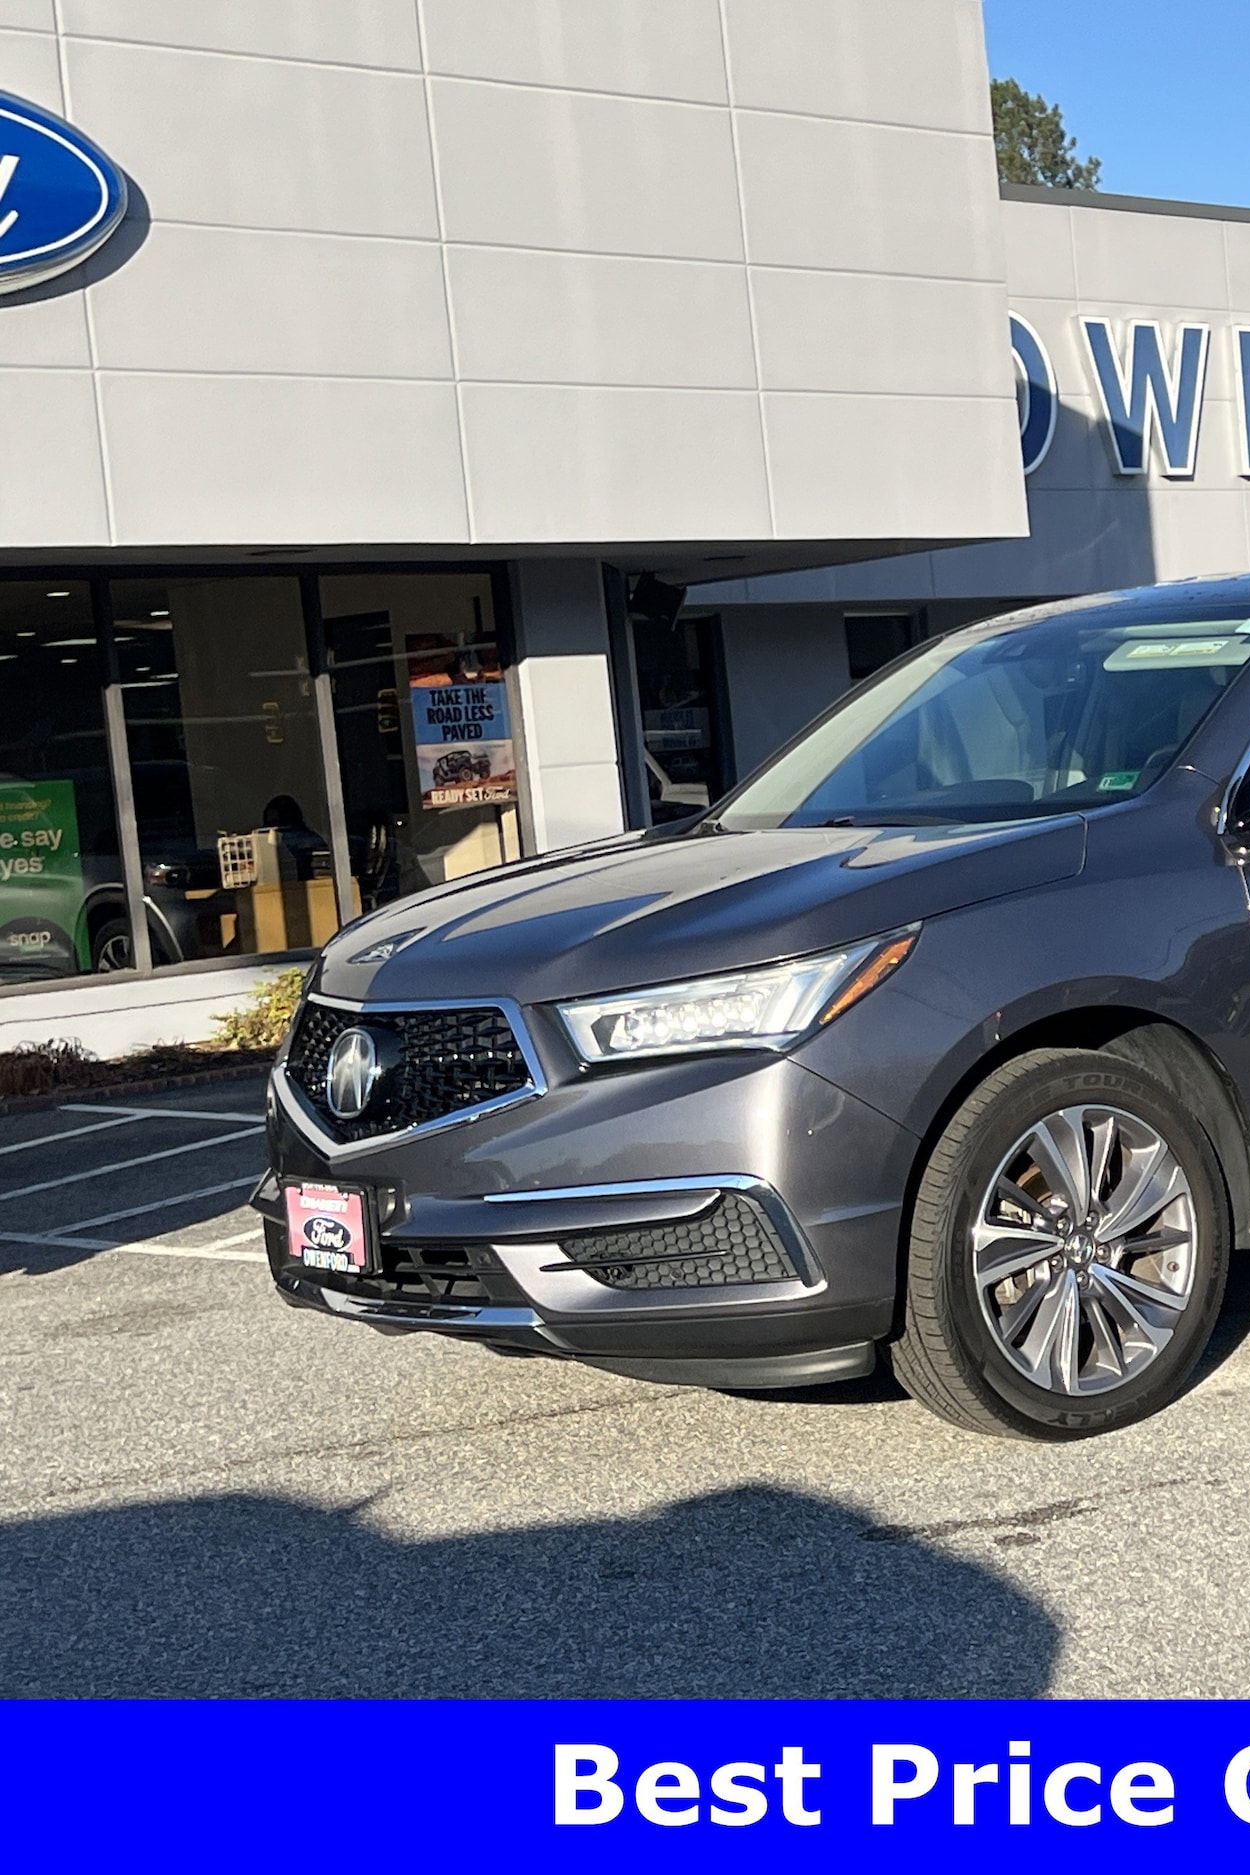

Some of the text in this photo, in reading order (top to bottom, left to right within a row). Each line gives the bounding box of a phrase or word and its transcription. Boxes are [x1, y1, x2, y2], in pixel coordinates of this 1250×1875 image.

[429, 688, 462, 707] TAKE
[427, 705, 495, 725] ROAD LESS
[442, 724, 483, 741] PAVED
[431, 786, 511, 805] READY SET Ford
[21, 829, 62, 850] say
[0, 857, 43, 880] yes
[9, 931, 51, 948] snap
[310, 1218, 345, 1248] Ford
